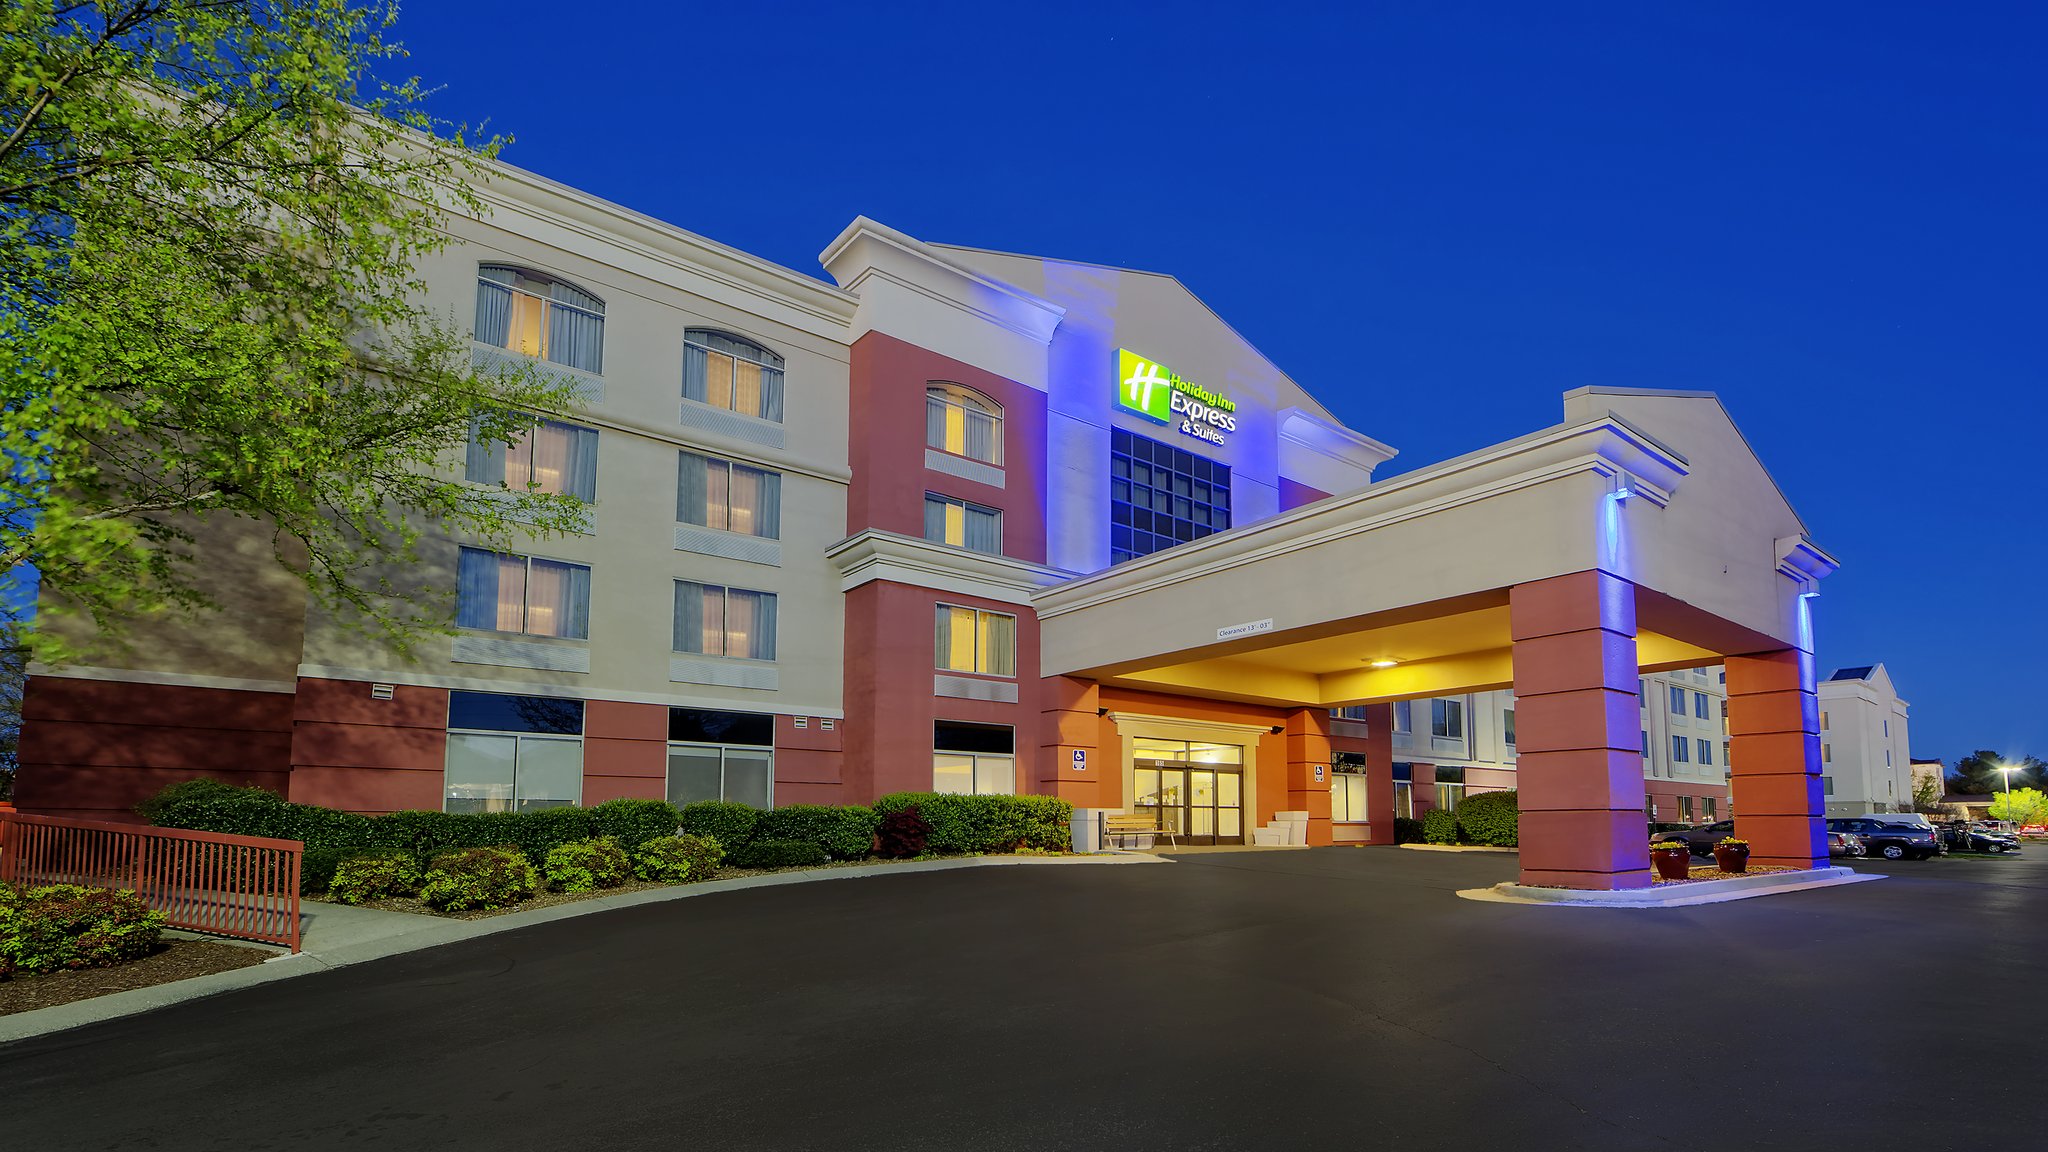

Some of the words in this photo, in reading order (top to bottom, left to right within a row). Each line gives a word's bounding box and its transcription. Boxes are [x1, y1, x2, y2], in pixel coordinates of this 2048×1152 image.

[1170, 373, 1216, 407] Holiday
[1217, 393, 1236, 412] Inn
[1170, 389, 1236, 431] Express
[1181, 419, 1191, 433] &
[1192, 424, 1225, 445] Suites
[1219, 628, 1246, 636] Clearance
